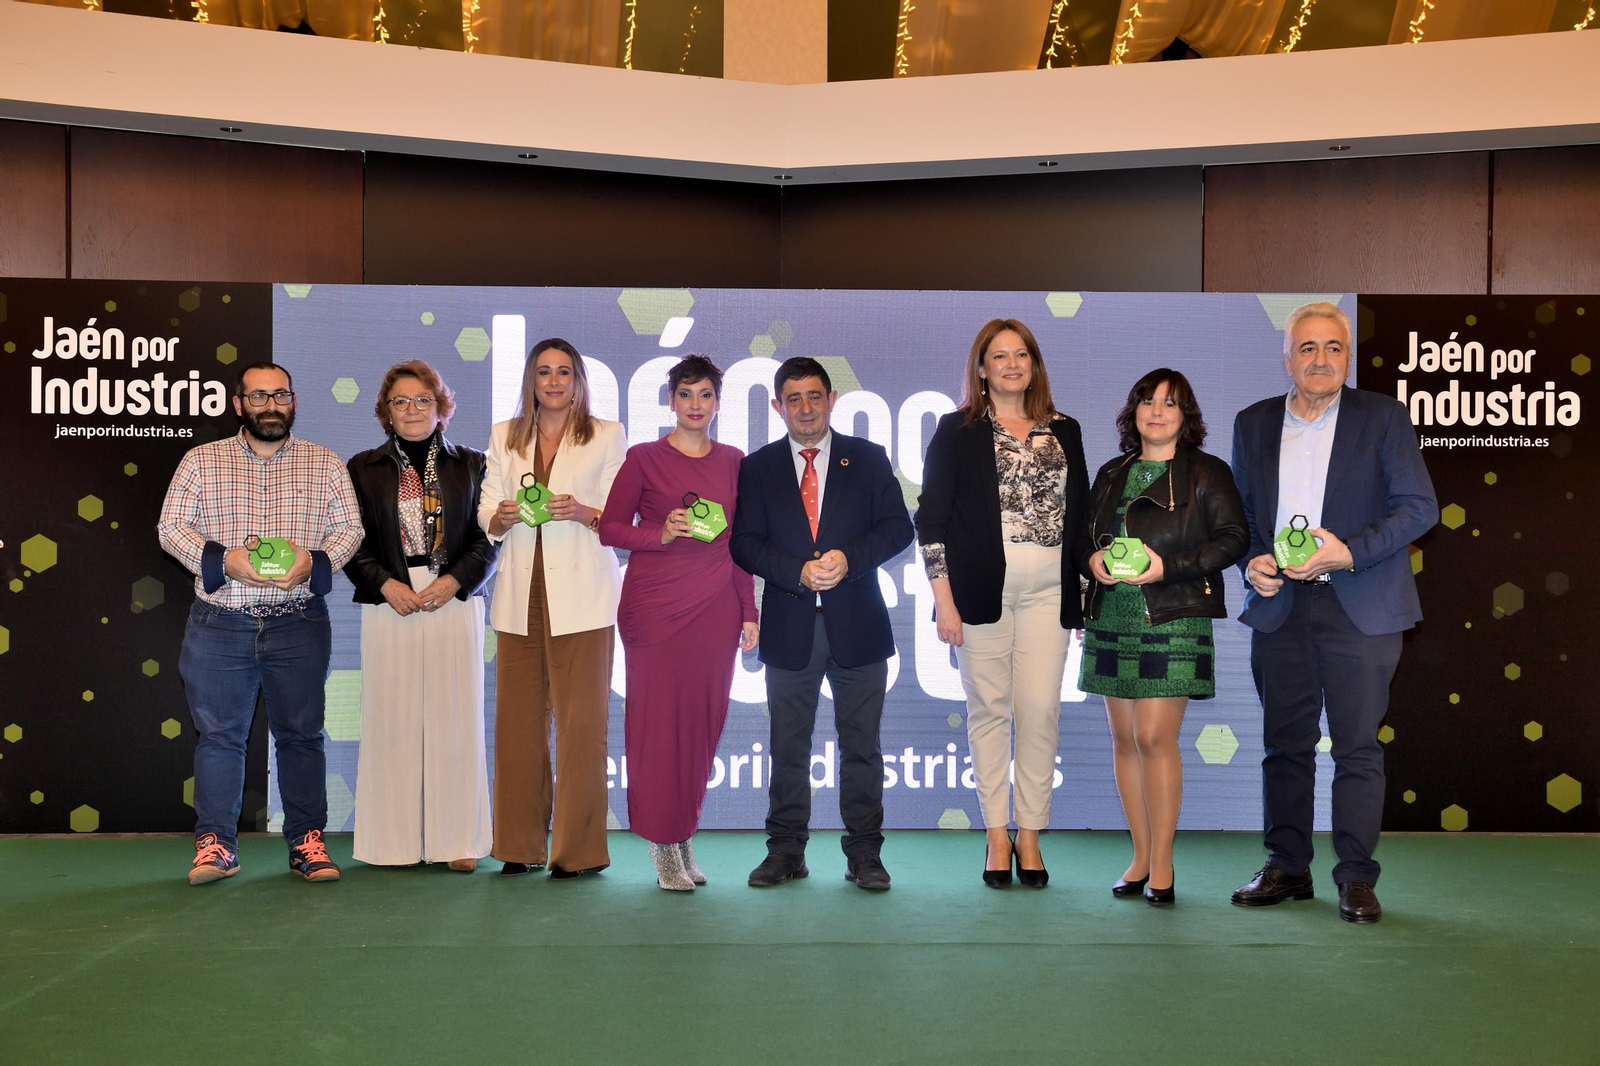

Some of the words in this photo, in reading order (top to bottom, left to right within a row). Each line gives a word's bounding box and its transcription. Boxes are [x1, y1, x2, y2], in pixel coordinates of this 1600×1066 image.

[32, 317, 124, 360] Jaén
[132, 337, 180, 368] por
[1398, 331, 1484, 373] Jaén
[1491, 349, 1536, 380] por
[31, 366, 227, 417] Industria
[1397, 379, 1581, 426] Industria
[55, 424, 194, 439] jaenporindustria.es
[1419, 435, 1550, 450] jaenporindustria.es
[260, 567, 286, 575] Industria
[1111, 568, 1138, 576] Industria
